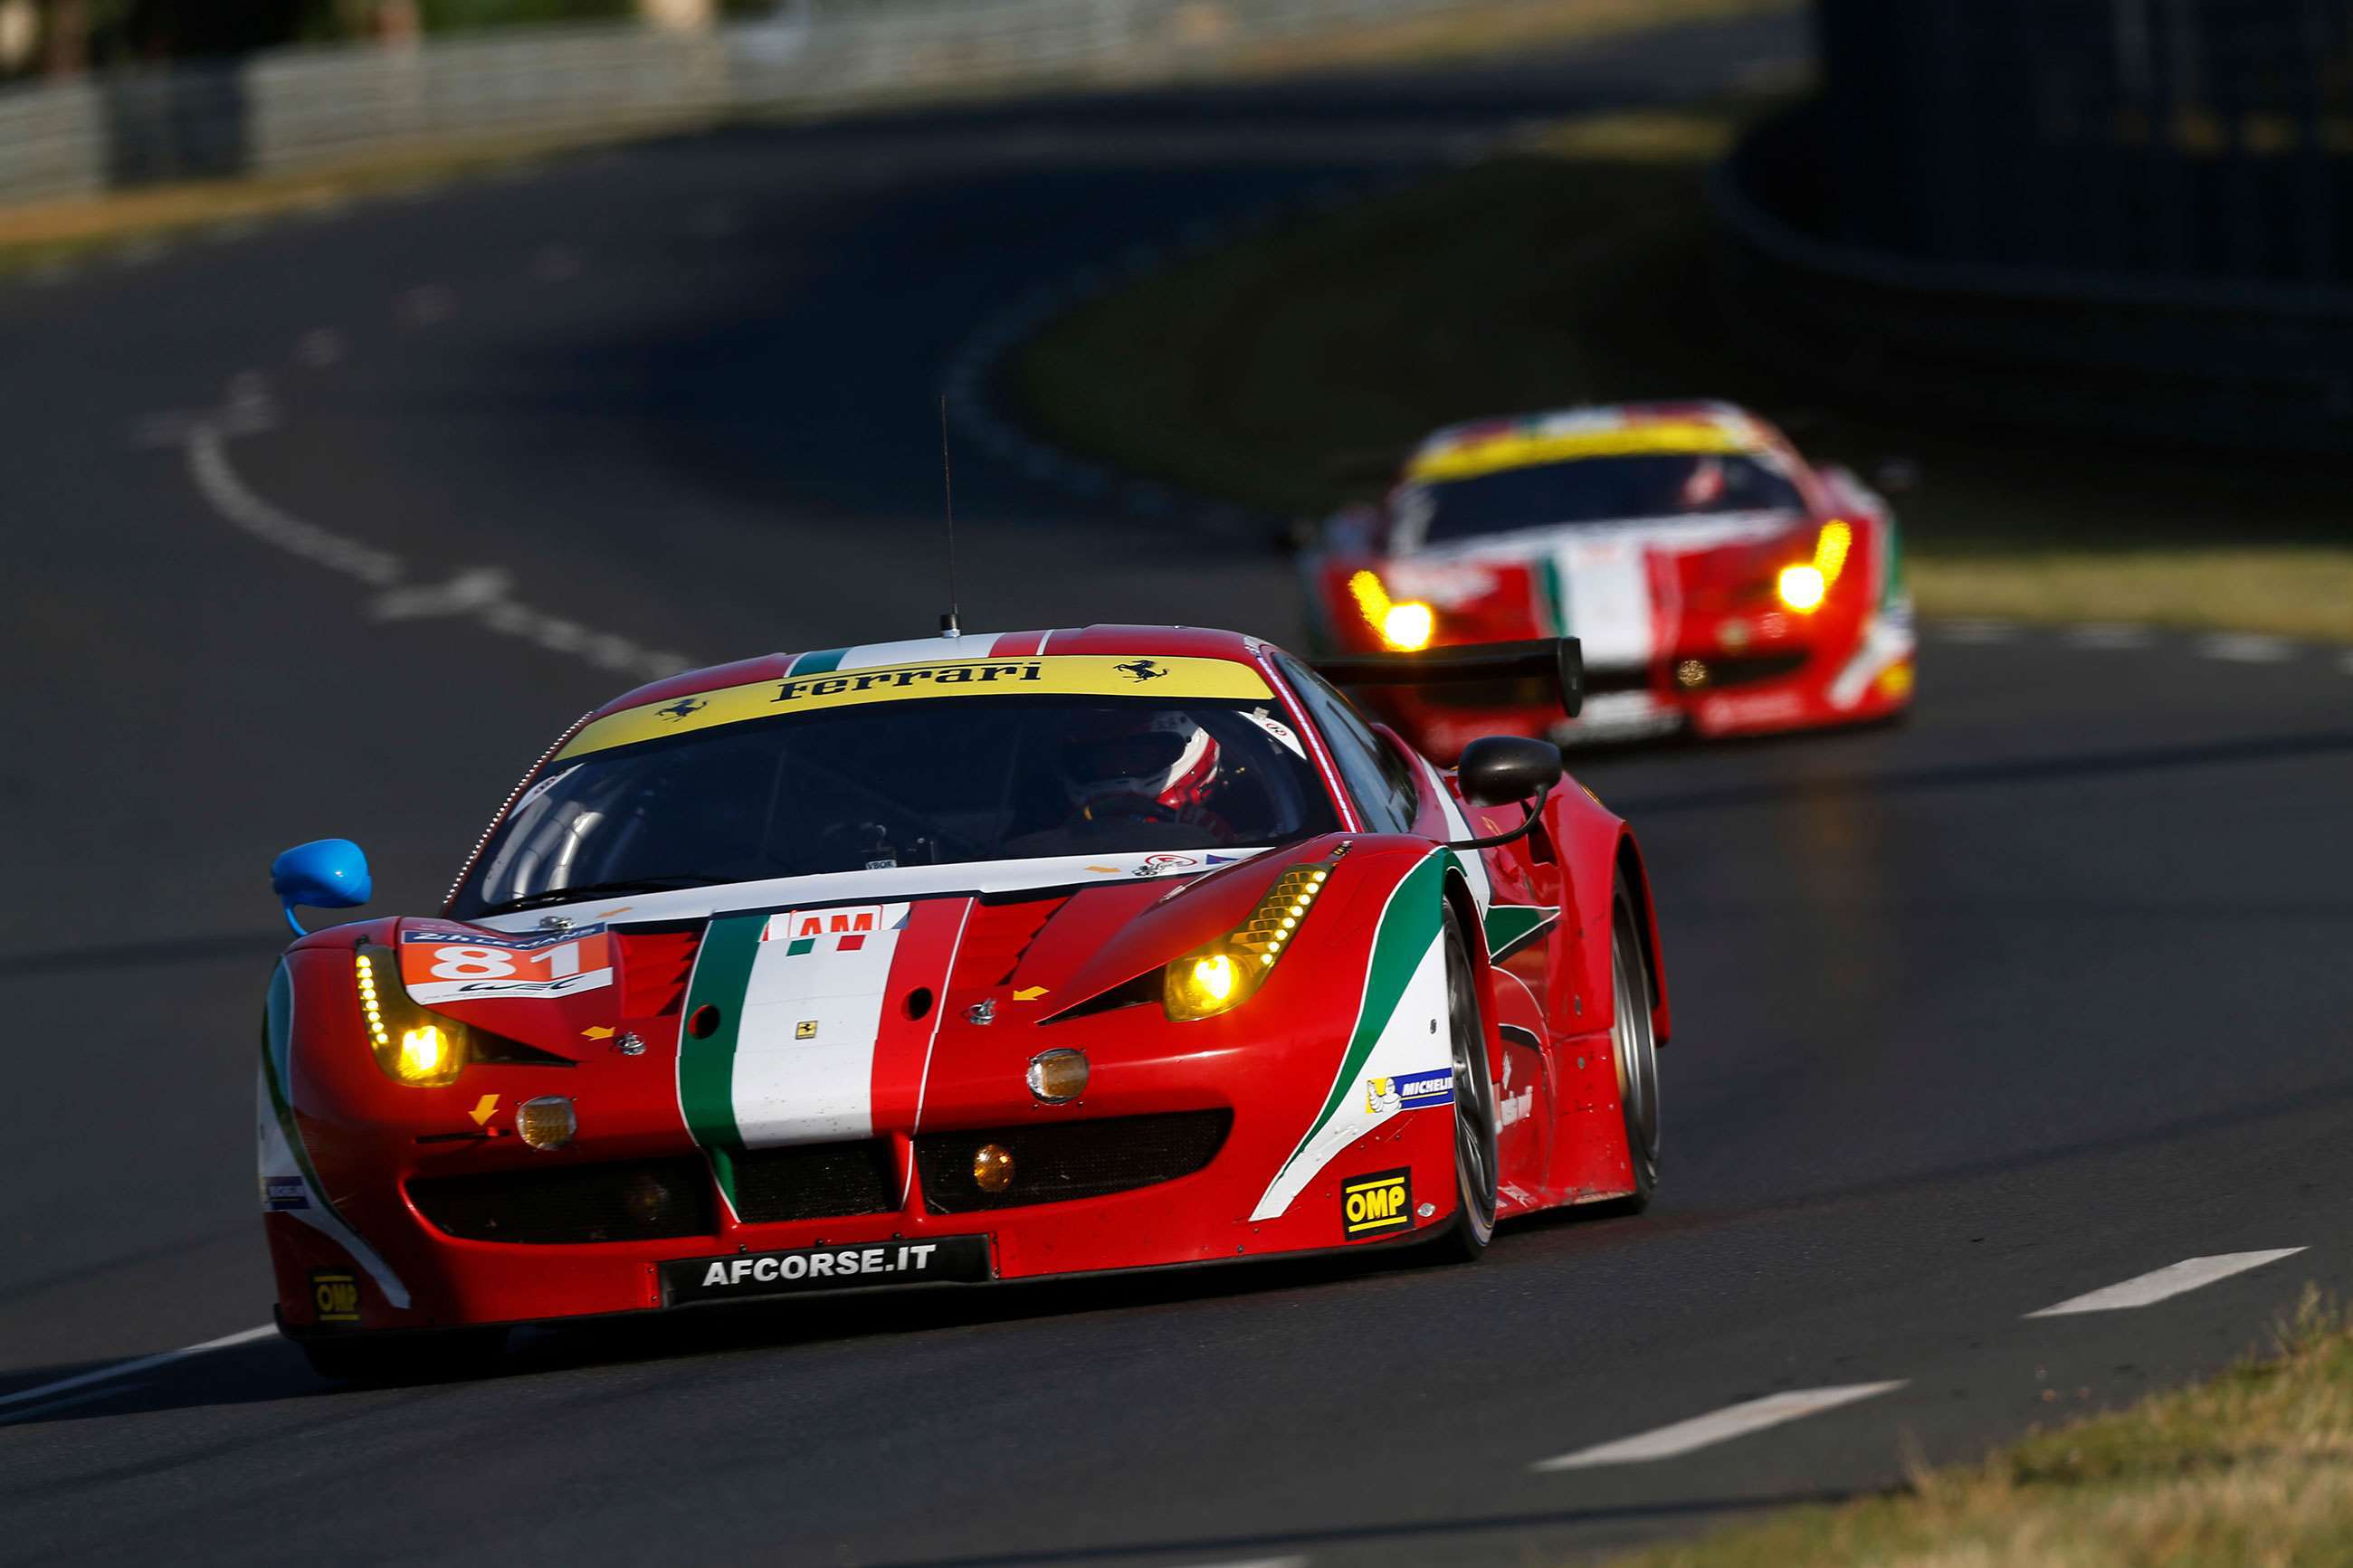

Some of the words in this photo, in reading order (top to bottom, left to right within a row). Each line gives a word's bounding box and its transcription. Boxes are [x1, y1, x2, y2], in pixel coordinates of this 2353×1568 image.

[769, 661, 1042, 702] Ferrari
[800, 912, 873, 936] AM
[430, 942, 579, 979] 81
[1346, 1185, 1405, 1222] OMP
[701, 1244, 936, 1287] AFCORSE.IT
[318, 1284, 357, 1312] OMP
